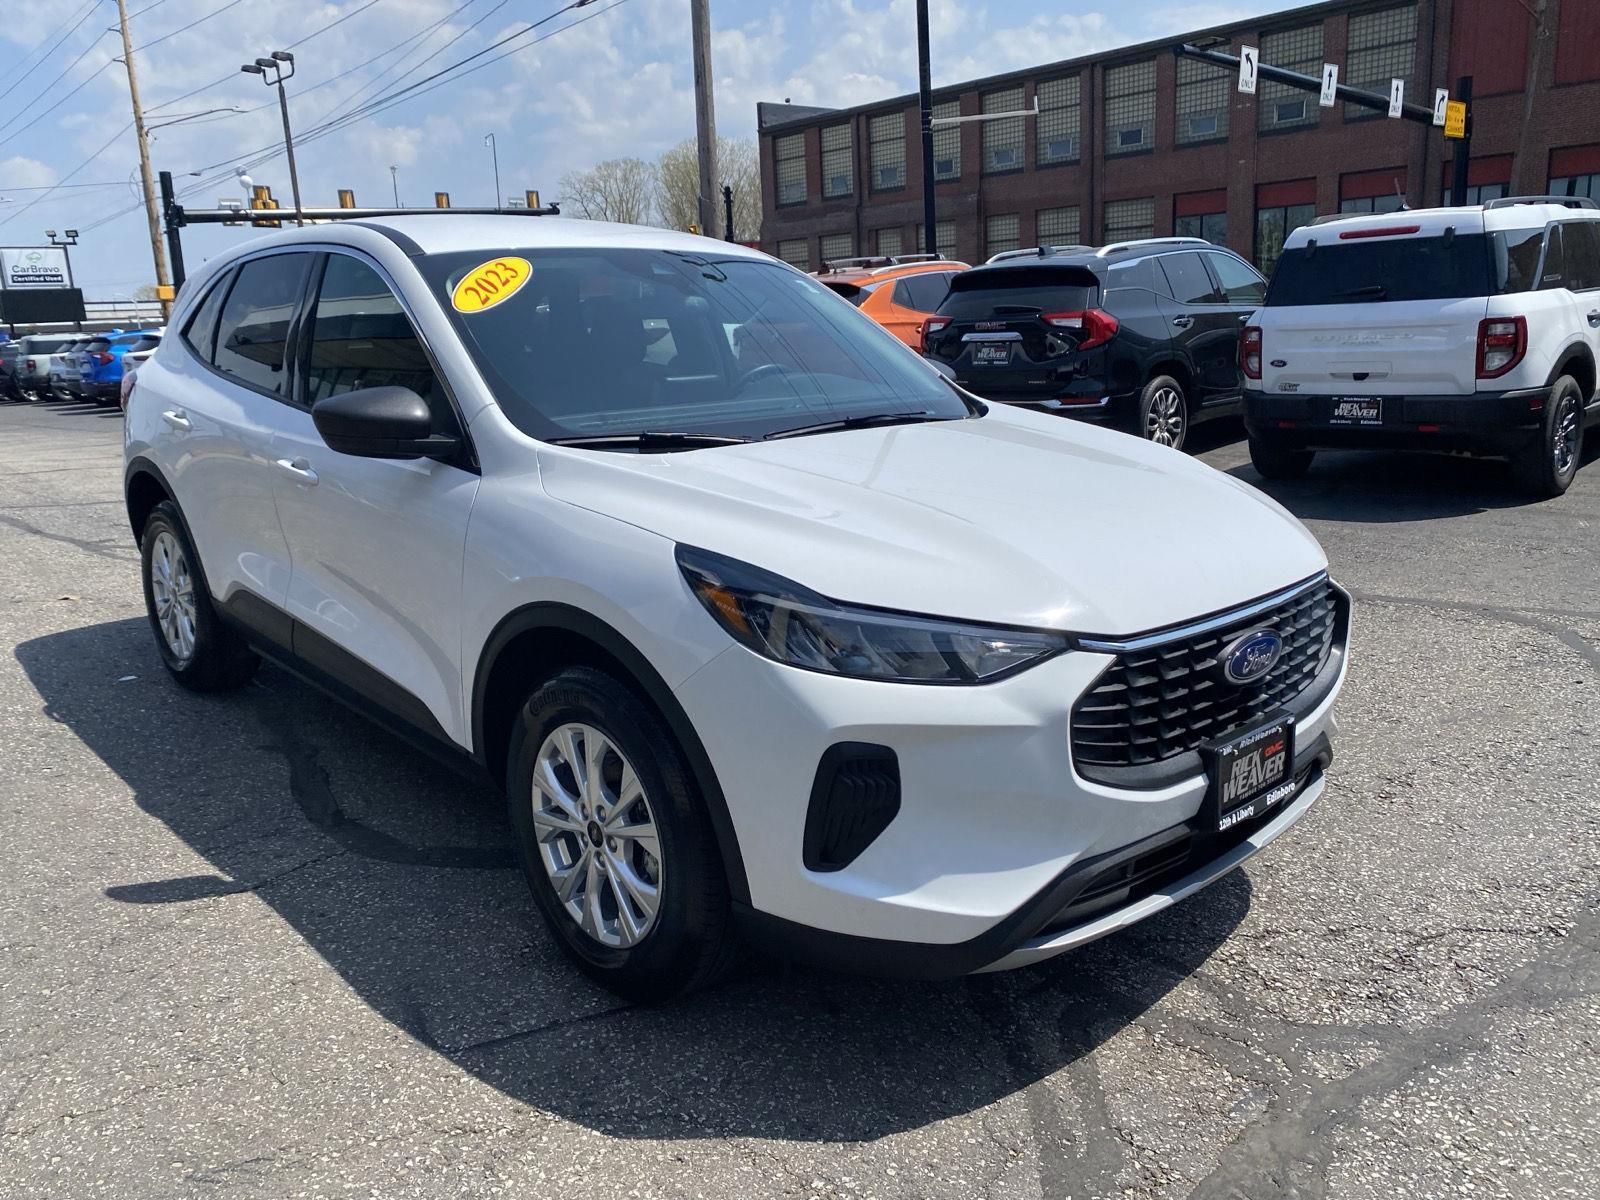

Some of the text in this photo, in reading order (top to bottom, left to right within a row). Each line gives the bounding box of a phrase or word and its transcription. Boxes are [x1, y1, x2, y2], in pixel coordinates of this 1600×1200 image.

[1241, 79, 1254, 88] ONLY
[1322, 92, 1333, 101] ONLY
[11, 264, 60, 273] CarBravo
[464, 262, 518, 305] 2023
[1334, 408, 1378, 416] WEAVER
[1340, 402, 1360, 411] RICK
[1263, 739, 1284, 757] GMC
[1231, 747, 1263, 780] RICK
[1223, 751, 1286, 803] WEAVER
[1266, 782, 1297, 806] Edinboro
[1219, 816, 1232, 831] 12th
[1236, 805, 1255, 822] Liberty
